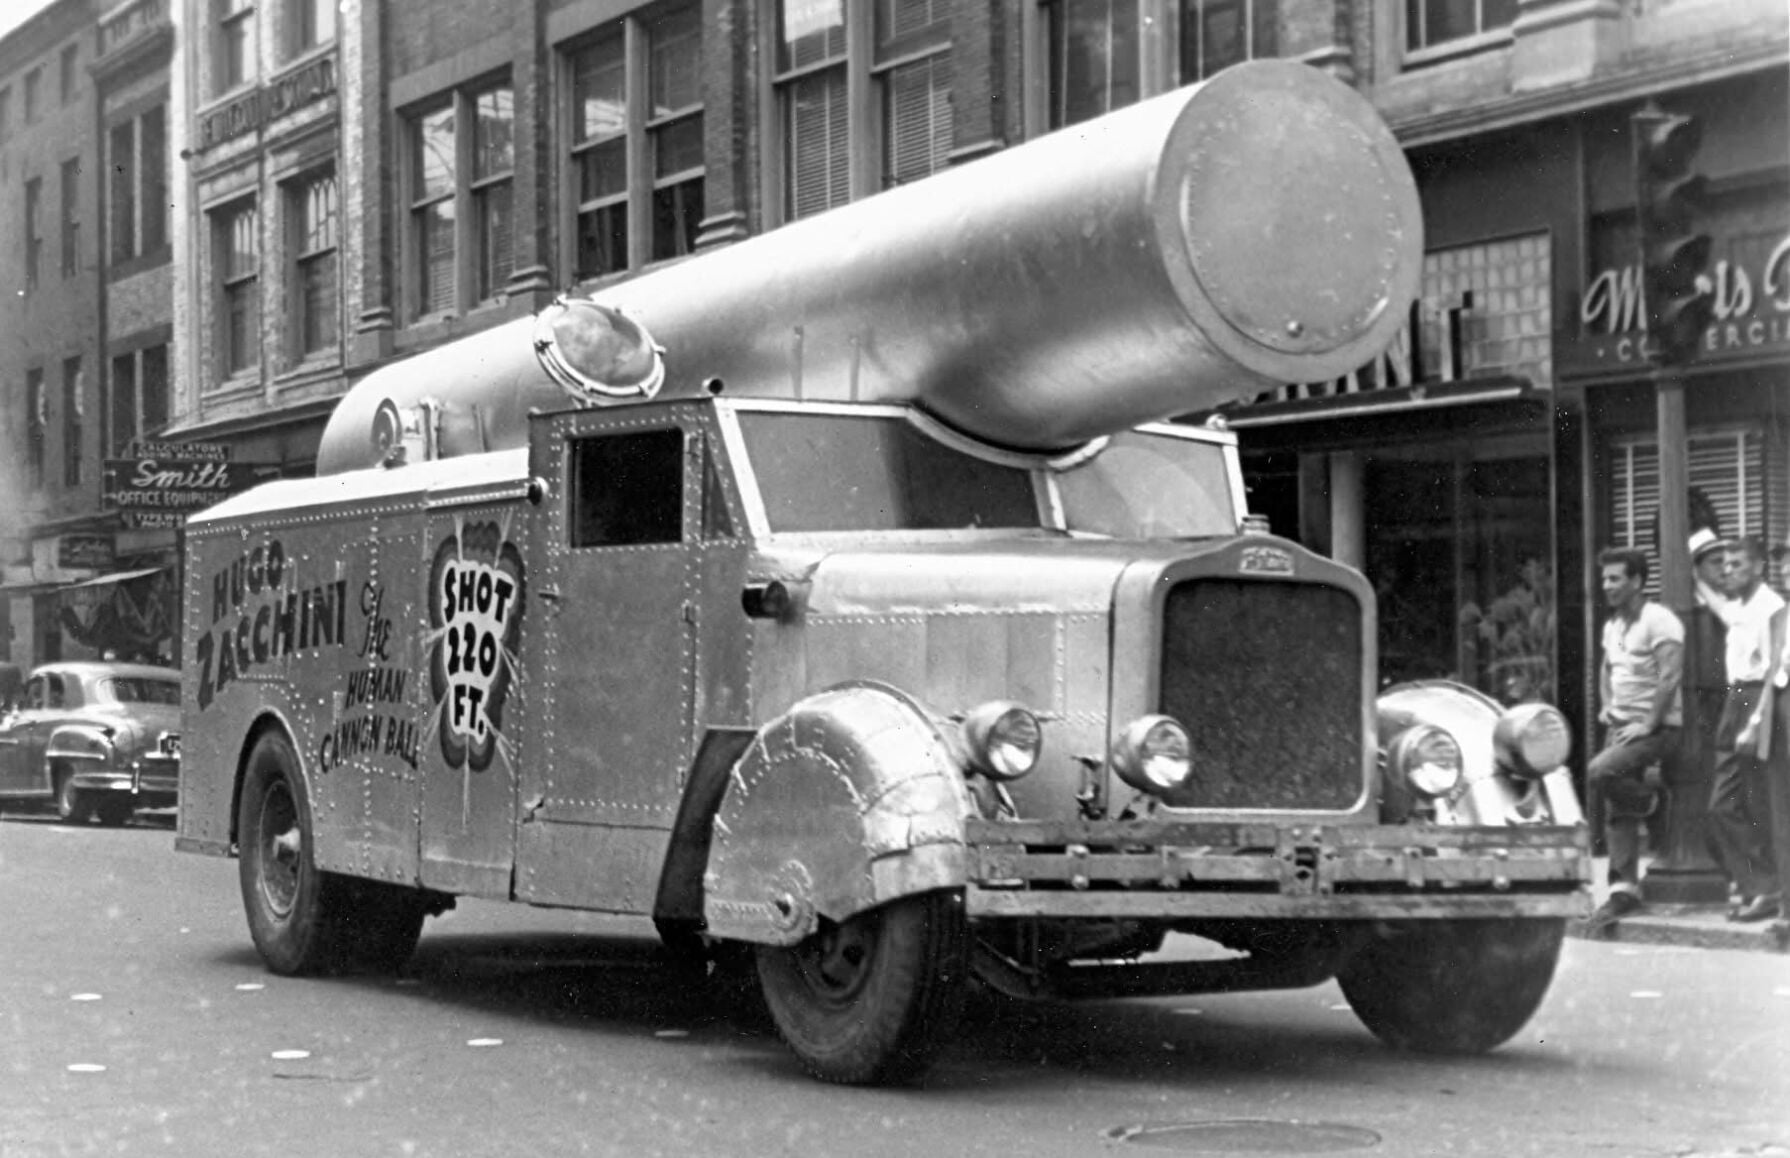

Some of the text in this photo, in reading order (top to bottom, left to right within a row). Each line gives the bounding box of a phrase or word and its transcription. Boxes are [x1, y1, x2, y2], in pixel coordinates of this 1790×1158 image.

[119, 491, 161, 505] OFFICE
[131, 460, 230, 488] Smith
[212, 540, 285, 626] HUGO
[445, 567, 513, 622] SHOT
[196, 579, 347, 711] ZACCHINI
[448, 623, 496, 677] 220
[345, 669, 406, 709] HUMAN
[454, 685, 484, 735] FT.
[320, 714, 419, 773] CANNON BALL
